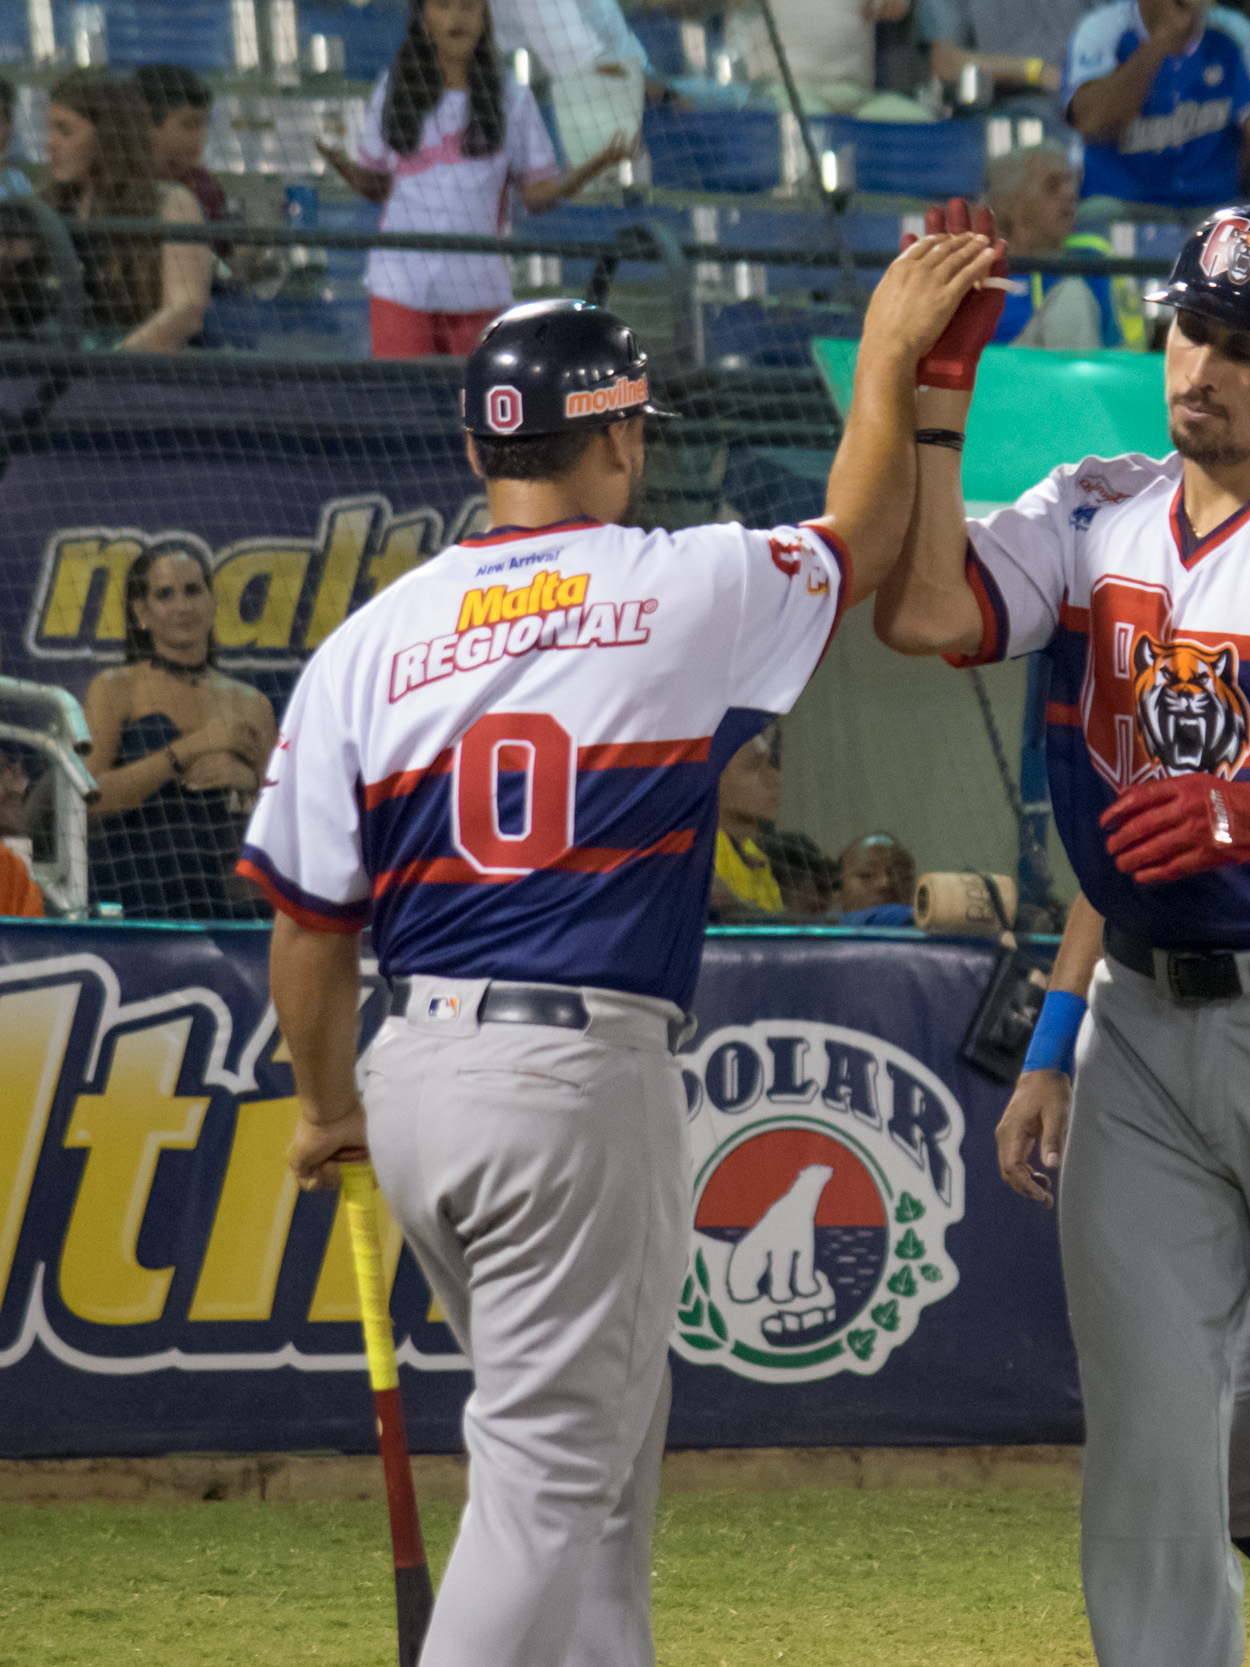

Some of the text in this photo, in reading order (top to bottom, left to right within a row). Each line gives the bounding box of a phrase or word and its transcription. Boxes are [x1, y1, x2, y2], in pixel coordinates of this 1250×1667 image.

[487, 385, 523, 435] 0
[457, 571, 591, 632] Malta
[452, 712, 578, 876] 0
